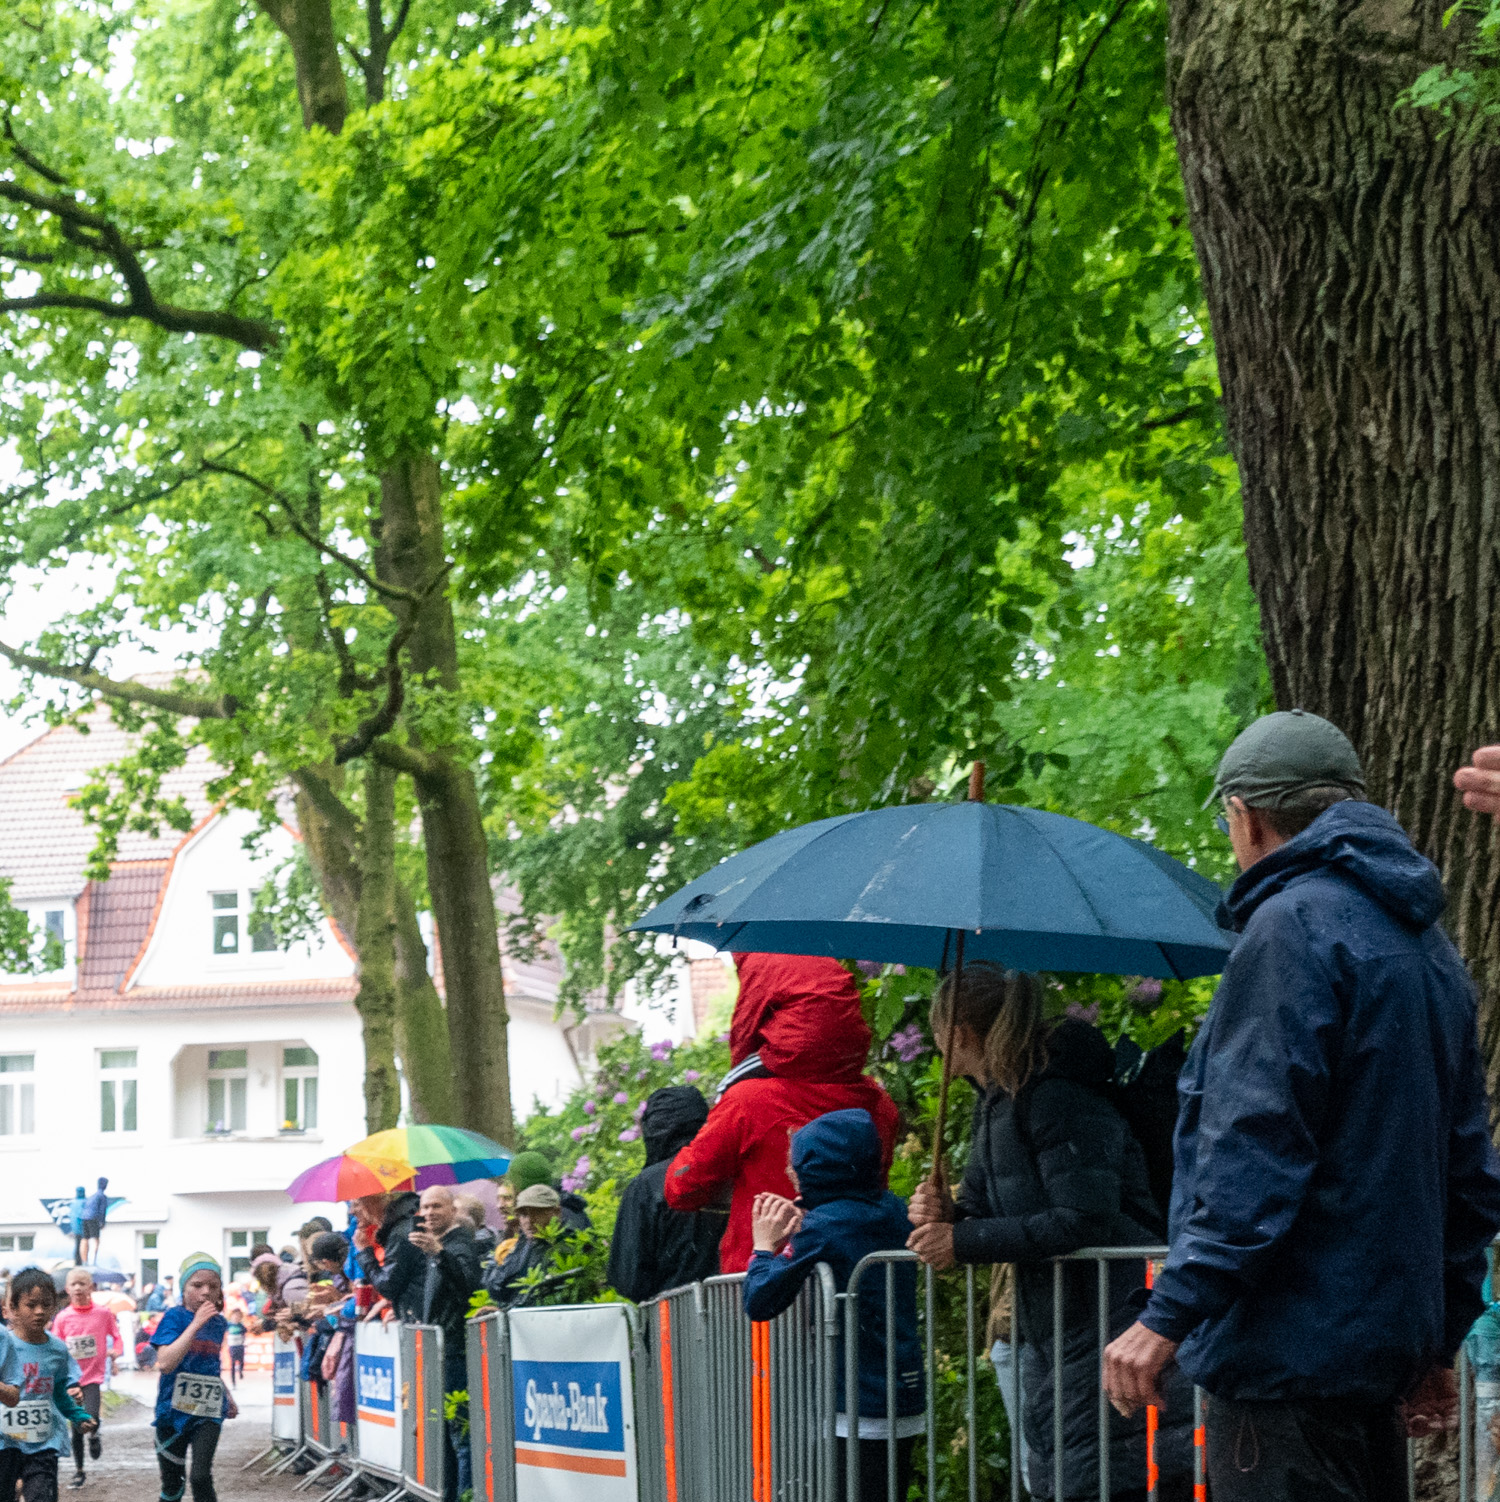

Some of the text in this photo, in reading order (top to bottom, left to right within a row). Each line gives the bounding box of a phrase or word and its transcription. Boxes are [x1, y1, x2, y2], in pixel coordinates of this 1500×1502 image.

[177, 1381, 222, 1401] 1379
[3, 1408, 51, 1427] 1833
[523, 1378, 609, 1440] Sparda-Bank
